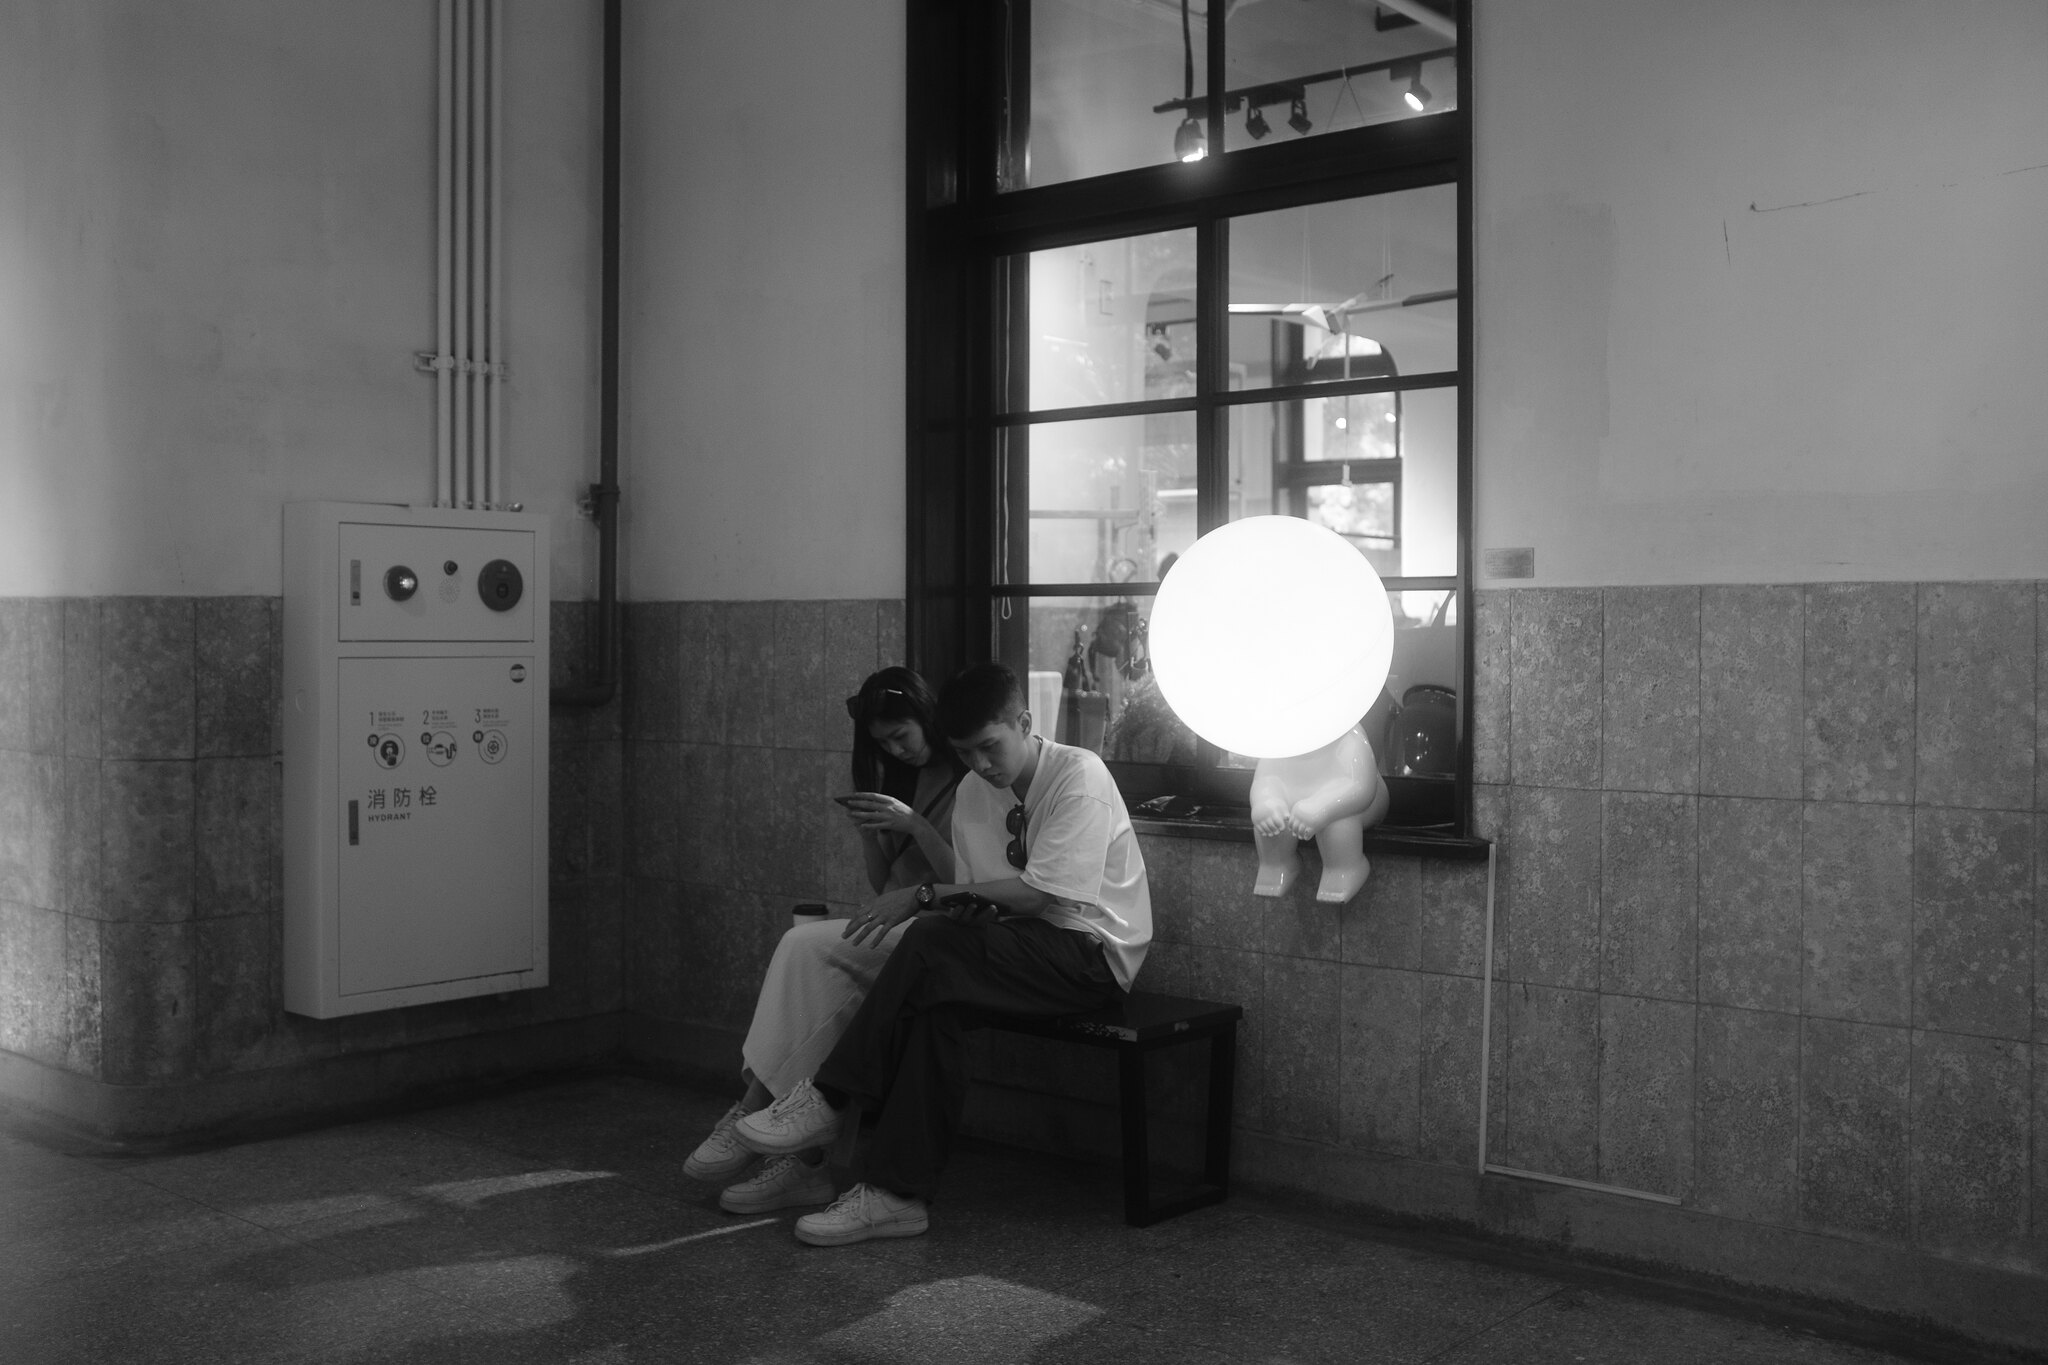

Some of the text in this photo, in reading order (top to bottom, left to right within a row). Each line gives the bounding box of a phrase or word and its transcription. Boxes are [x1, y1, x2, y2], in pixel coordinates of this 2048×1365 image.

[369, 712, 374, 726] 1
[423, 710, 430, 725] 2
[474, 709, 481, 724] 3
[368, 786, 437, 808] 消防栓
[368, 812, 411, 822] HYDRANT
